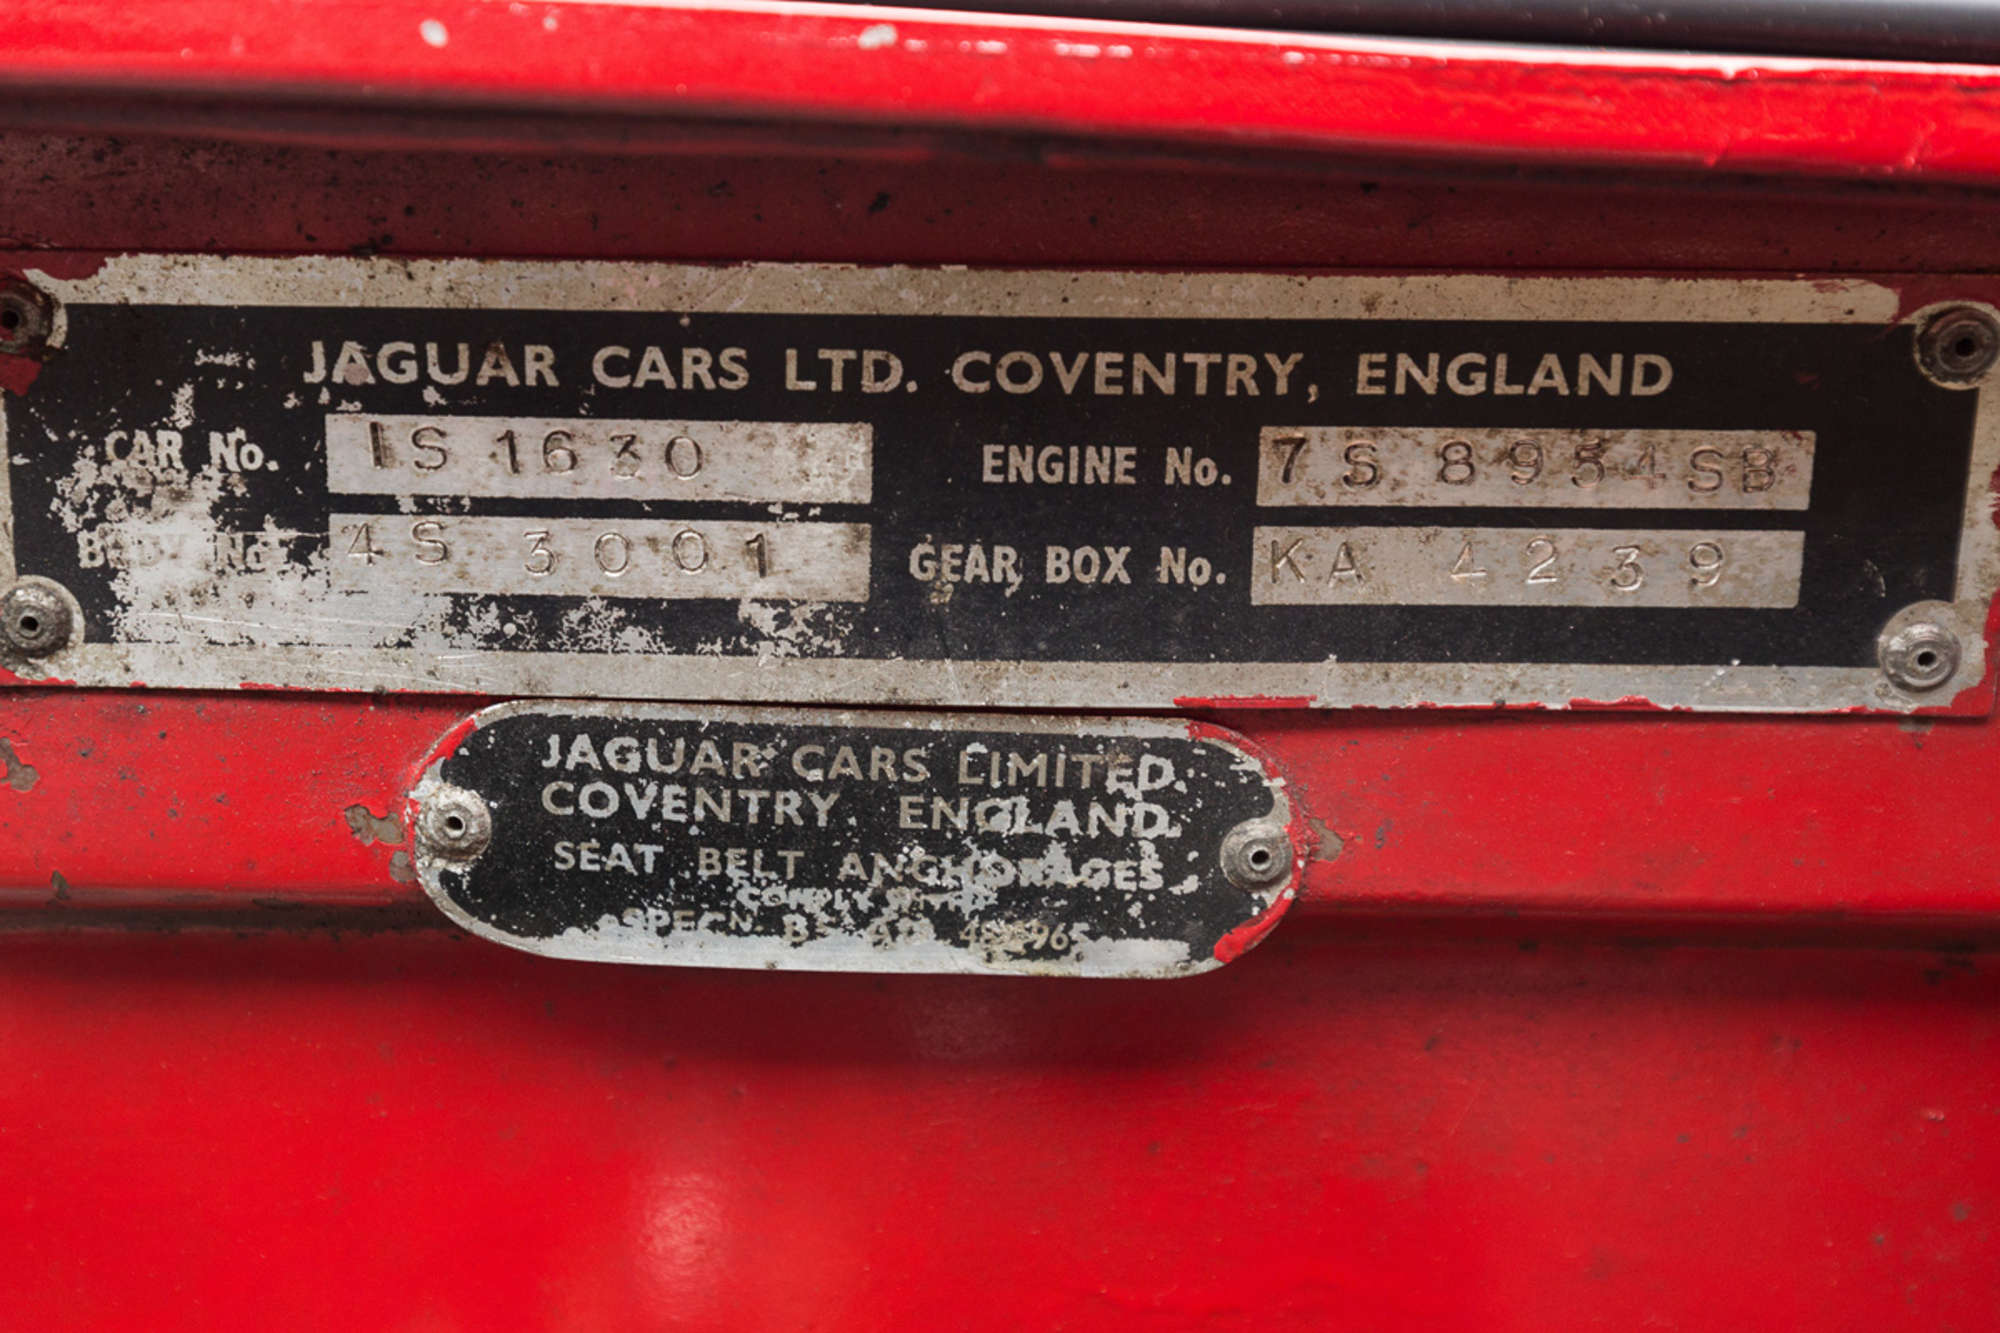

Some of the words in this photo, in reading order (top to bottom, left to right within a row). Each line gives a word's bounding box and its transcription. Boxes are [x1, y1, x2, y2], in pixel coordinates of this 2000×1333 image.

[303, 341, 559, 389] JAGUAR
[592, 345, 749, 391] CARS
[785, 348, 918, 394] LTD.
[951, 350, 1319, 402] COVENTRY,
[1356, 352, 1673, 397] ENGLAND
[105, 429, 184, 470] CAR
[209, 427, 279, 472] No.
[982, 443, 1137, 486] ENGINE
[1165, 445, 1231, 487] No.
[909, 542, 1021, 585] GEAR
[1045, 543, 1132, 585] BOX
[1158, 545, 1227, 587] No.
[541, 733, 763, 781] JAGUAR
[791, 744, 931, 783] CARS
[541, 780, 840, 828] COVENTRY
[553, 838, 664, 876] SEAT
[697, 847, 805, 883] BELT
